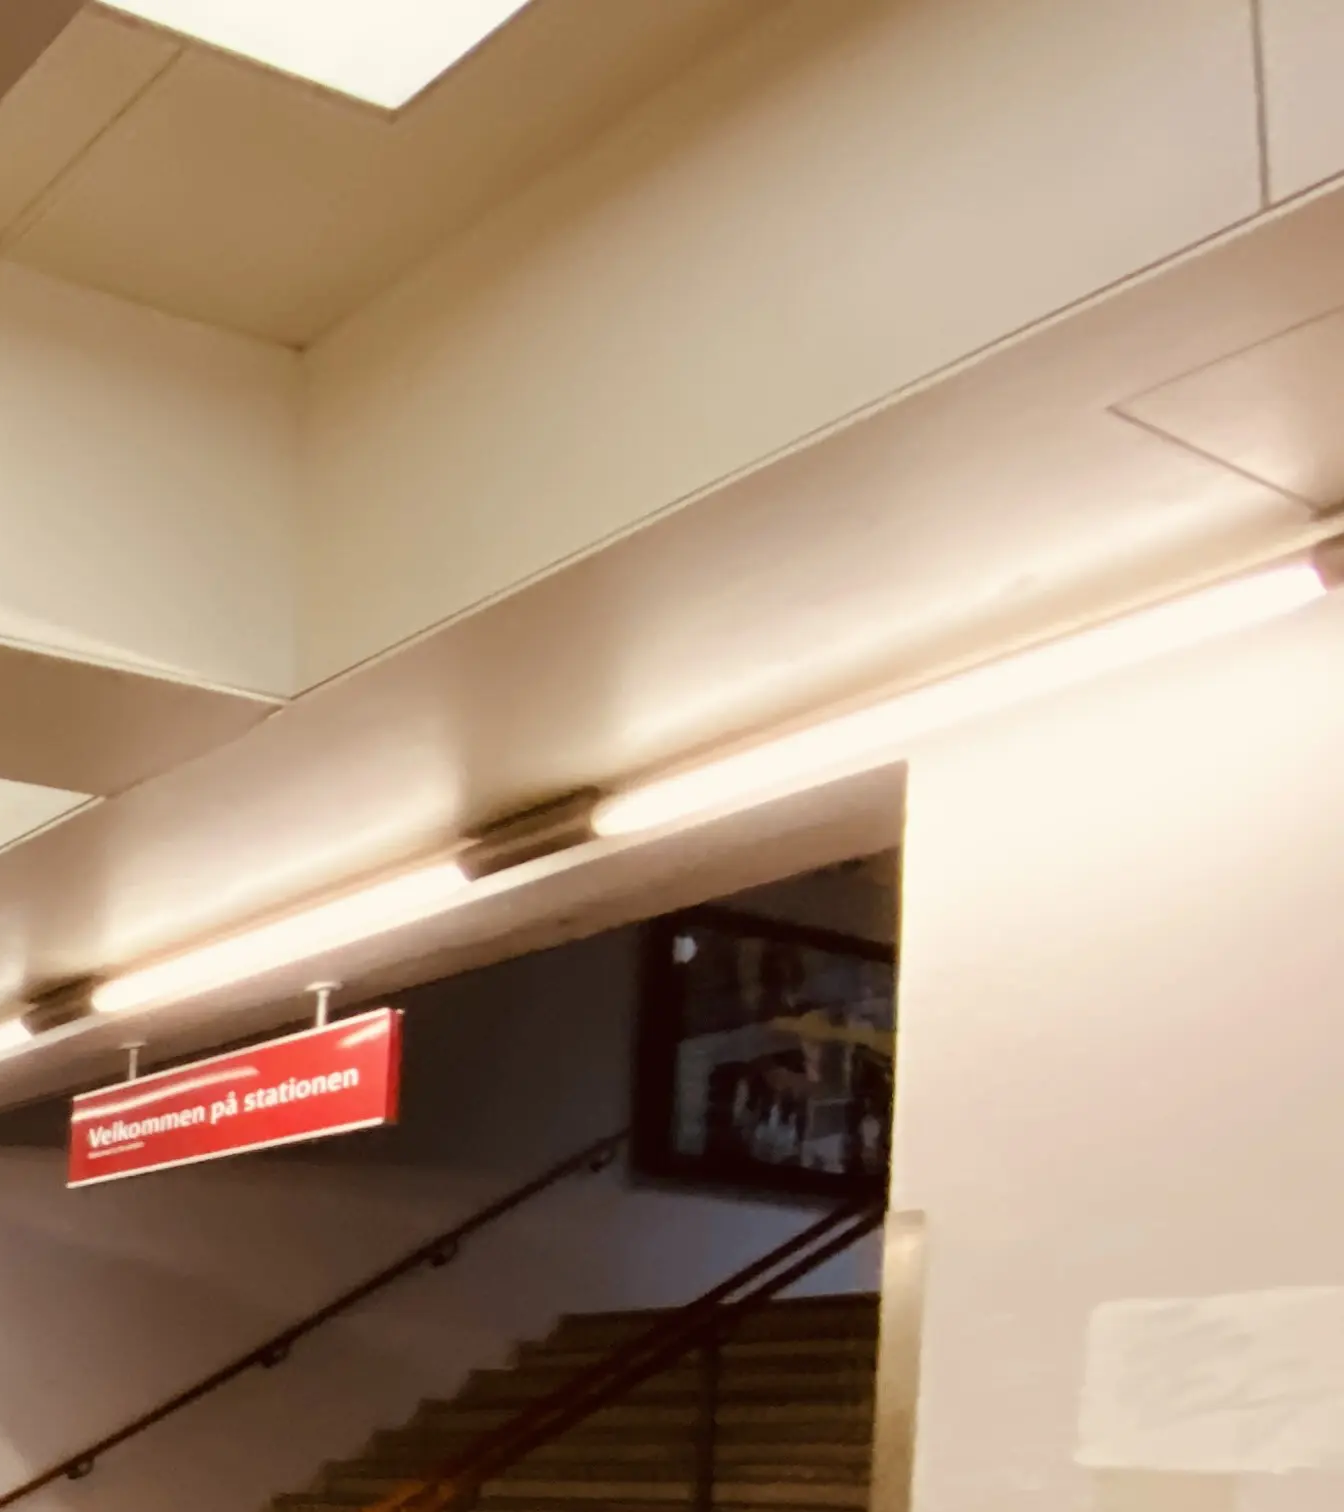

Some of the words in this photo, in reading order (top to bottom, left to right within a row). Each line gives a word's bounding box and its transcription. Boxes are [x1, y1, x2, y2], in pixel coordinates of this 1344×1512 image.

[87, 1105, 206, 1149] Velkommen
[210, 1091, 238, 1124] på
[243, 1067, 360, 1112] stationen
